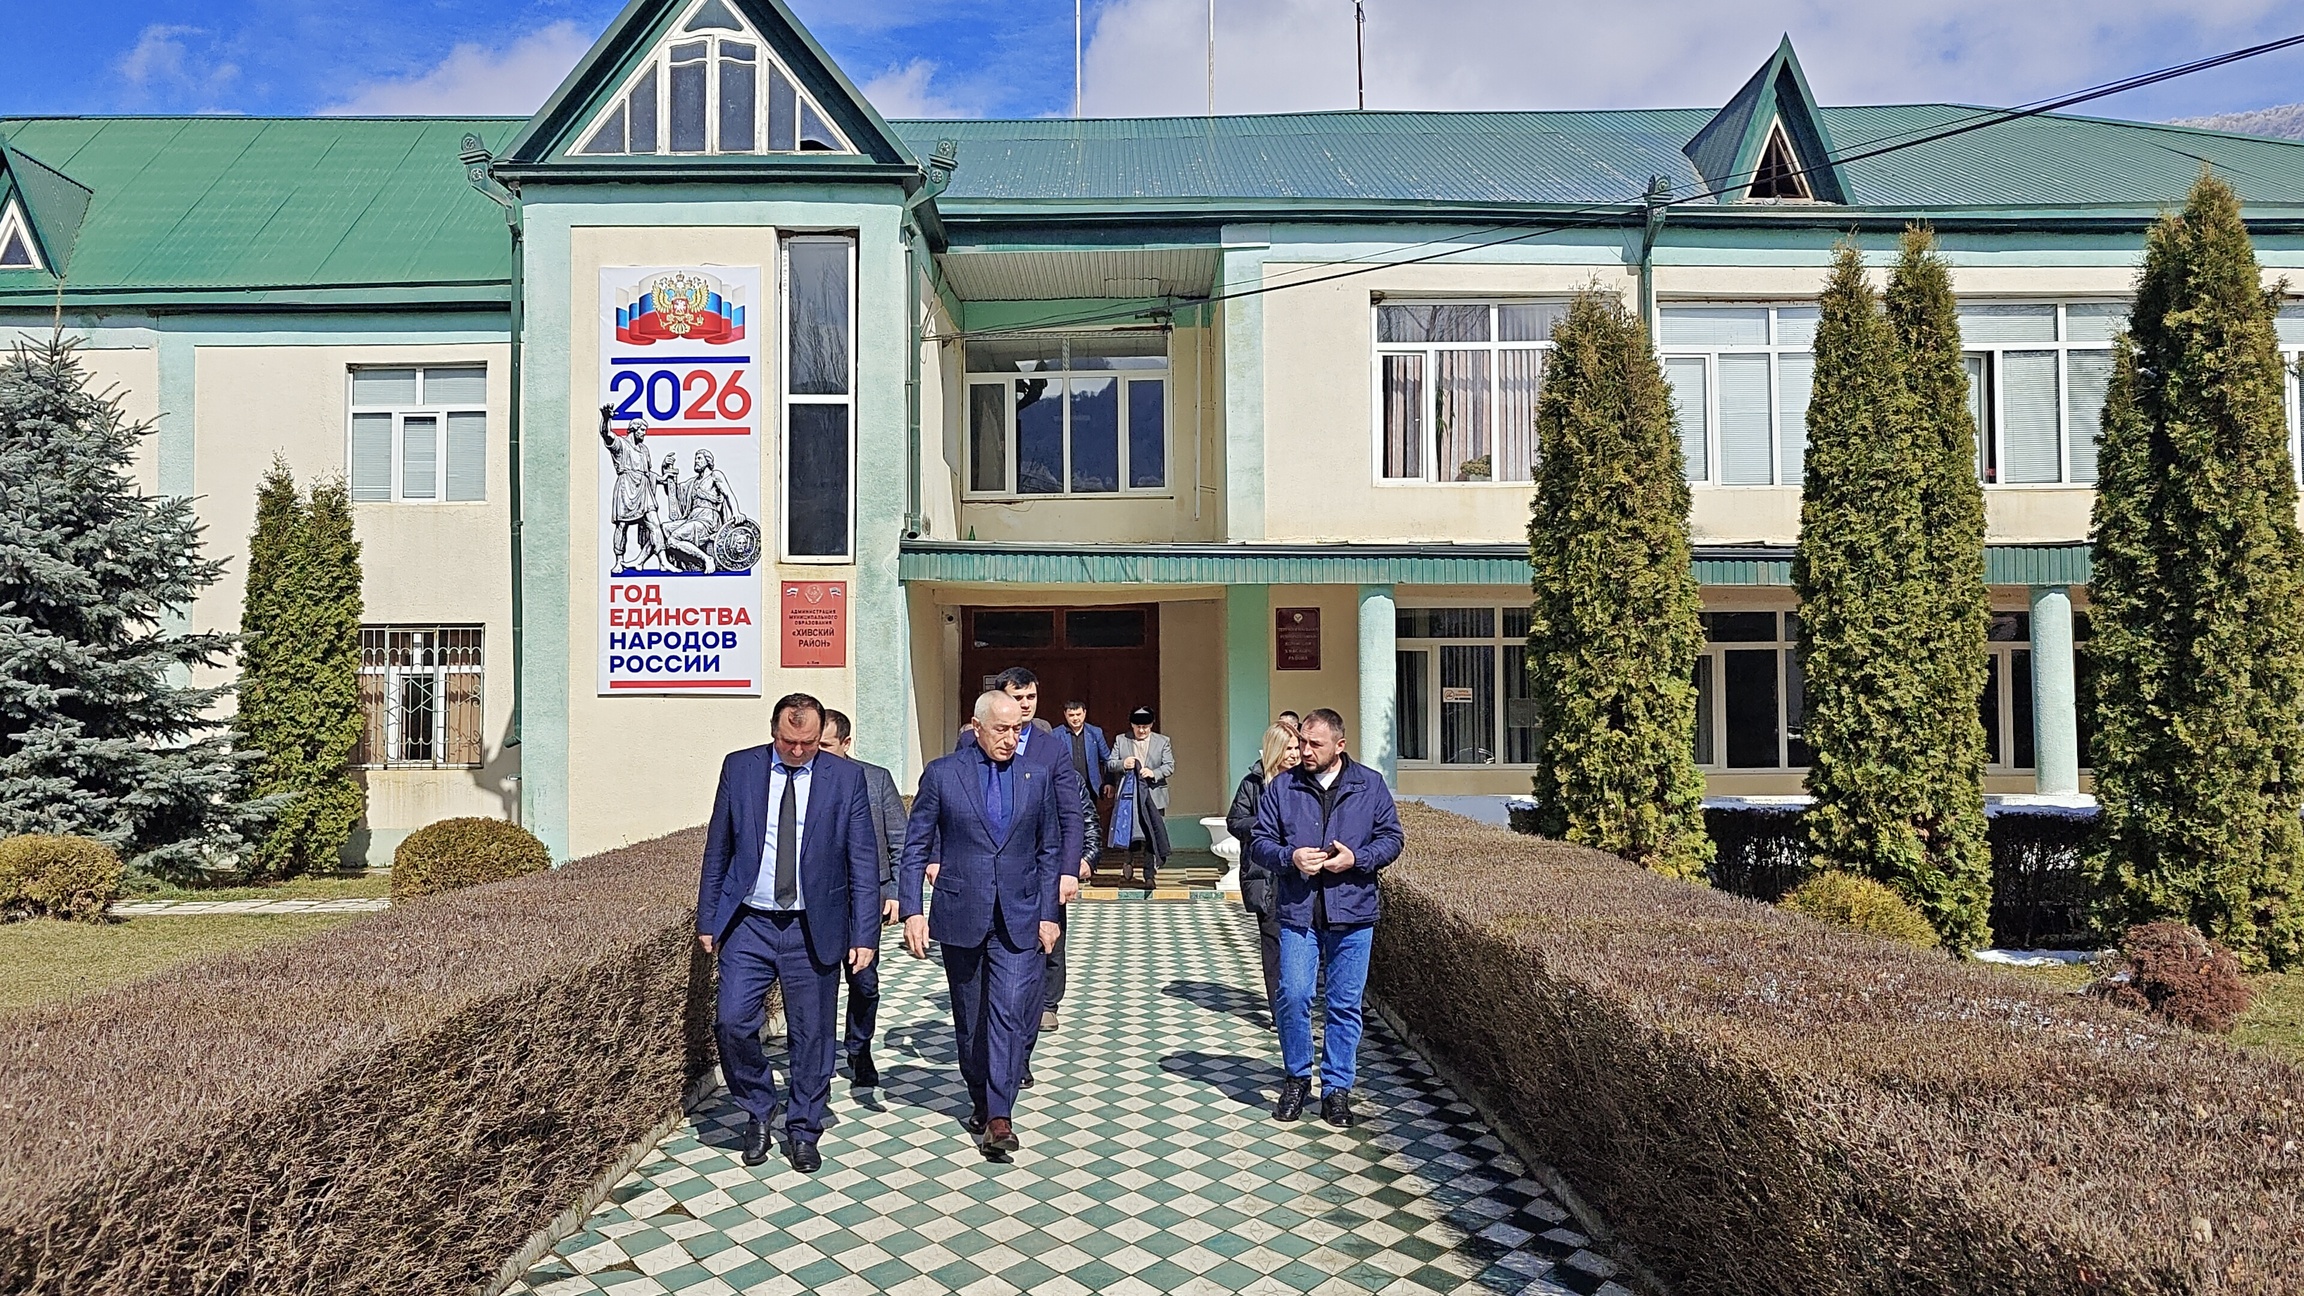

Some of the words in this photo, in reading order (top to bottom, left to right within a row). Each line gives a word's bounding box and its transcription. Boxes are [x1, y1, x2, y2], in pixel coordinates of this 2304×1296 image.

[610, 370, 751, 421] 2026
[610, 585, 662, 605] ГОД
[610, 607, 752, 629] ЕДИНСТВА
[610, 631, 738, 653] НАРОДОВ
[791, 627, 835, 637] «ХИВСКИЙ
[798, 638, 831, 648] РАЙОН»
[610, 655, 720, 673] РОССИИ
